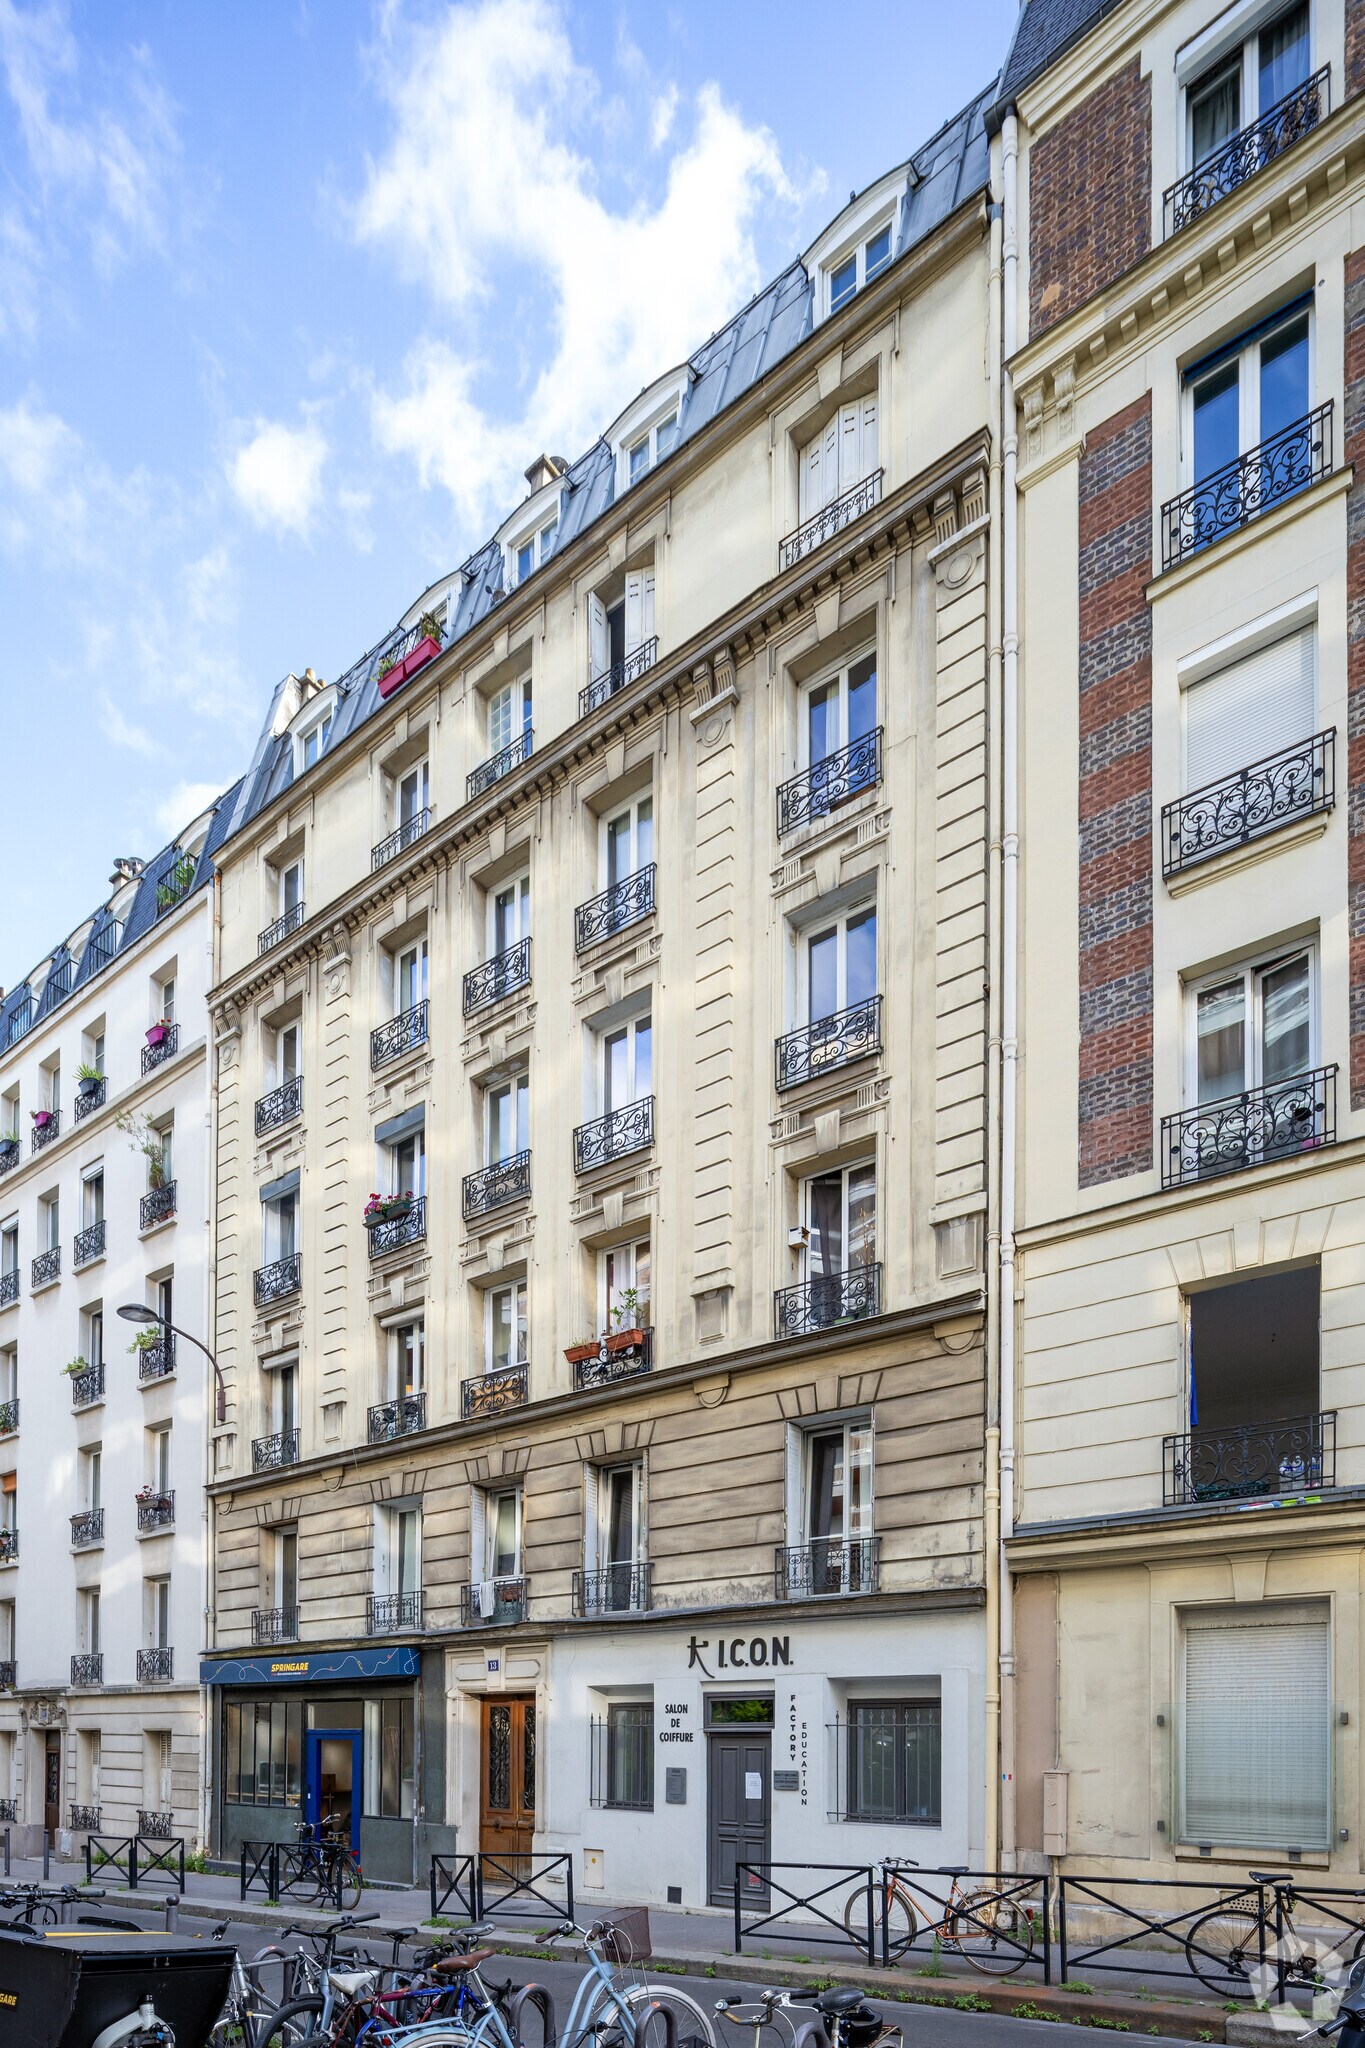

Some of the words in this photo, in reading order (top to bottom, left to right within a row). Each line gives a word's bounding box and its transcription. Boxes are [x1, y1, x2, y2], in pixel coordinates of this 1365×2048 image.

[271, 1662, 309, 1672] SPRINGARE
[489, 1661, 497, 1670] 13
[665, 1703, 688, 1714] SALON
[670, 1718, 680, 1728] DE
[789, 1694, 797, 1761] FACTORY
[800, 1722, 808, 1806] EDUCATION
